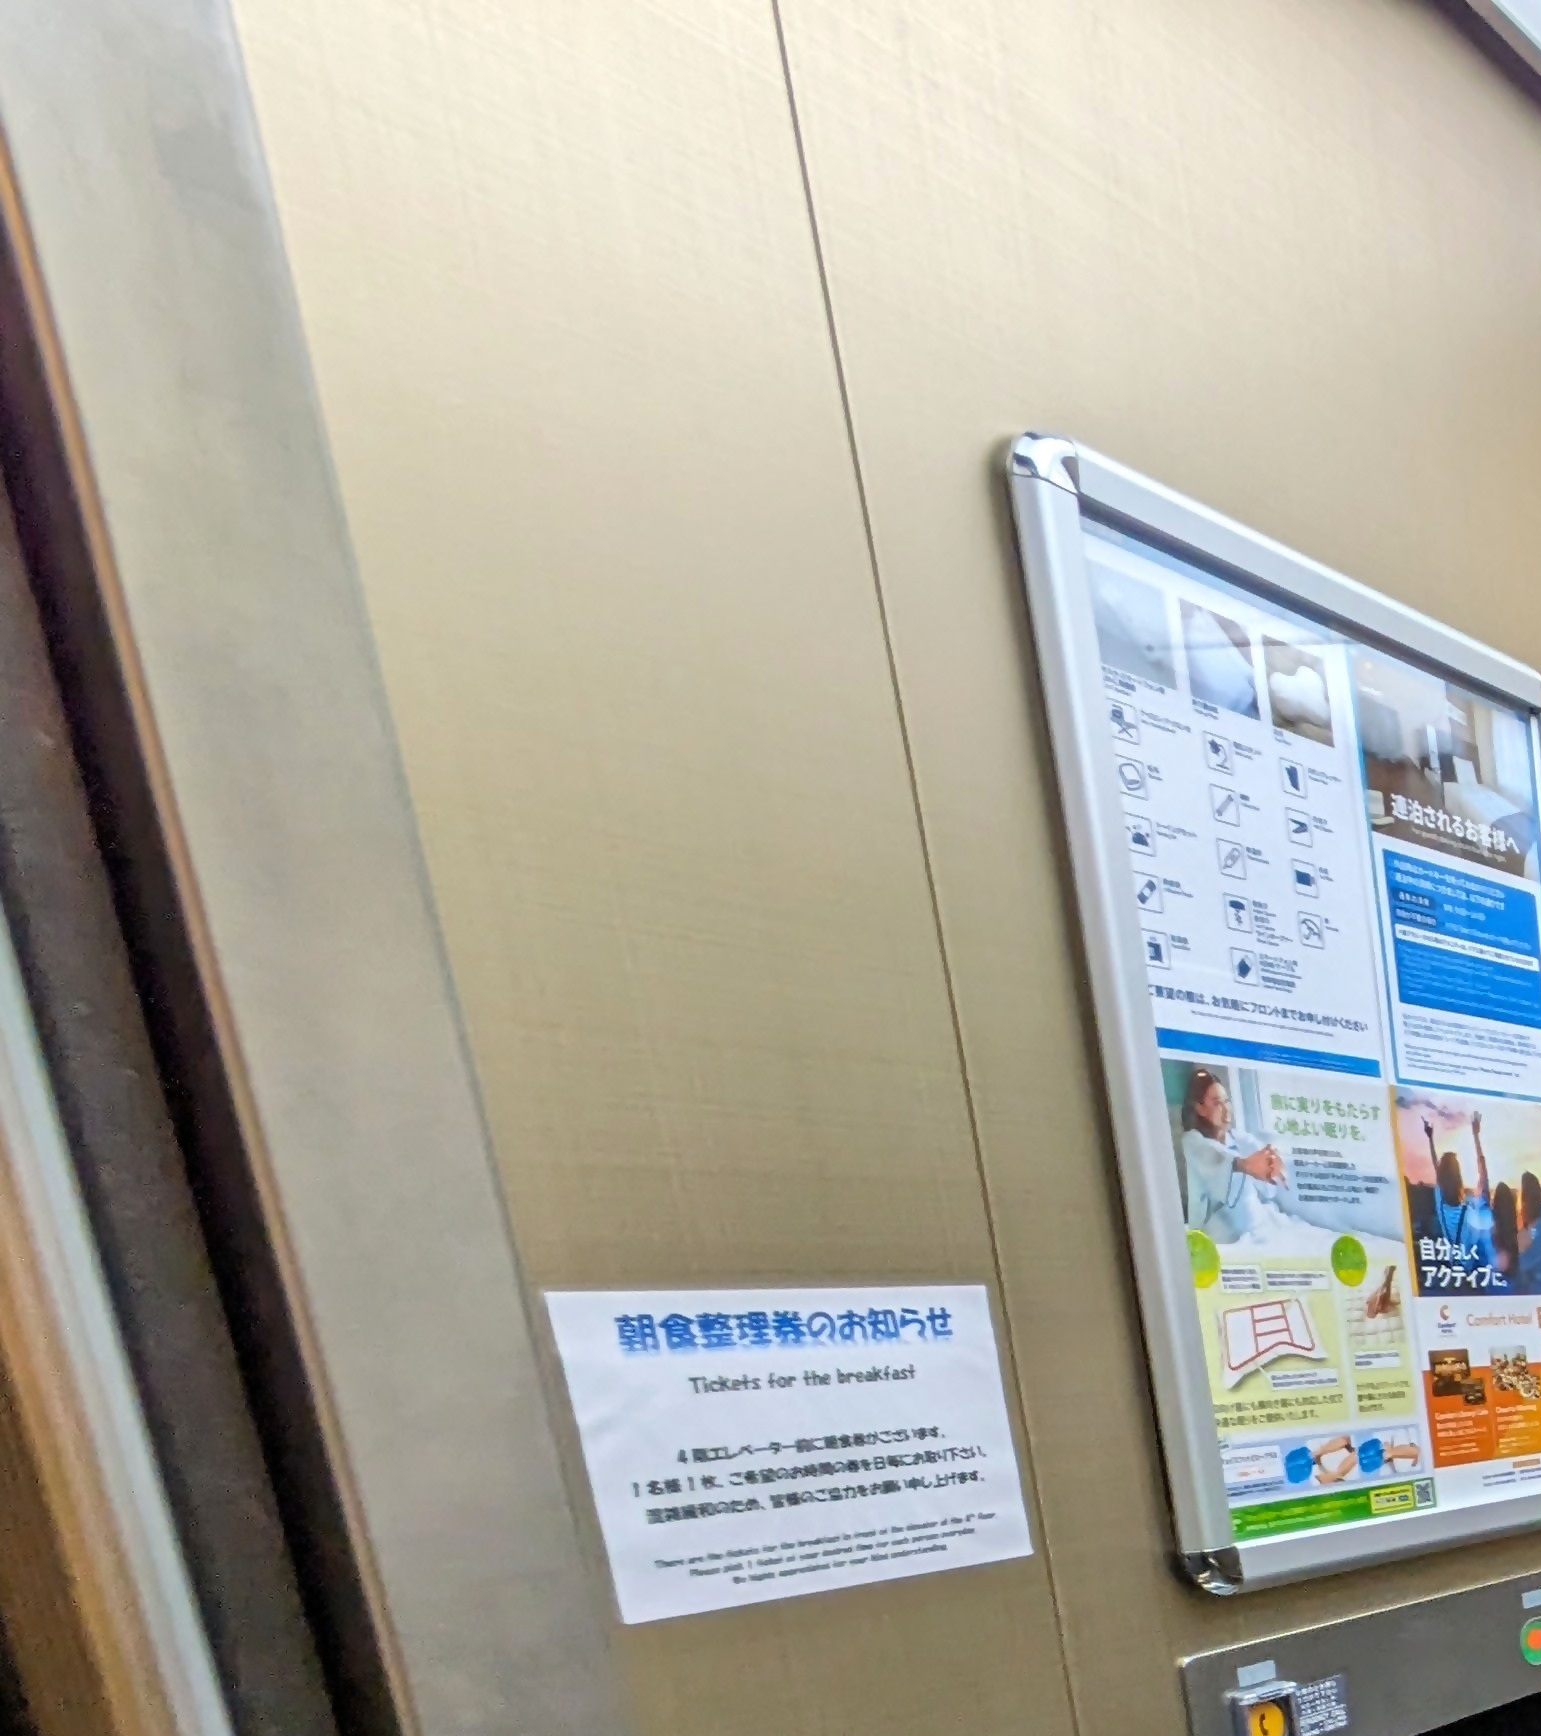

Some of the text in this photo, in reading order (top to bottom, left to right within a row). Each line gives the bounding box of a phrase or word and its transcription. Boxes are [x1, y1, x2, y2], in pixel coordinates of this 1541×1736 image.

[1418, 1236, 1480, 1261] 自分らしく
[614, 1306, 954, 1352] 朝食整理券のお知らせ
[688, 1364, 917, 1394] Tickets for the breakfast
